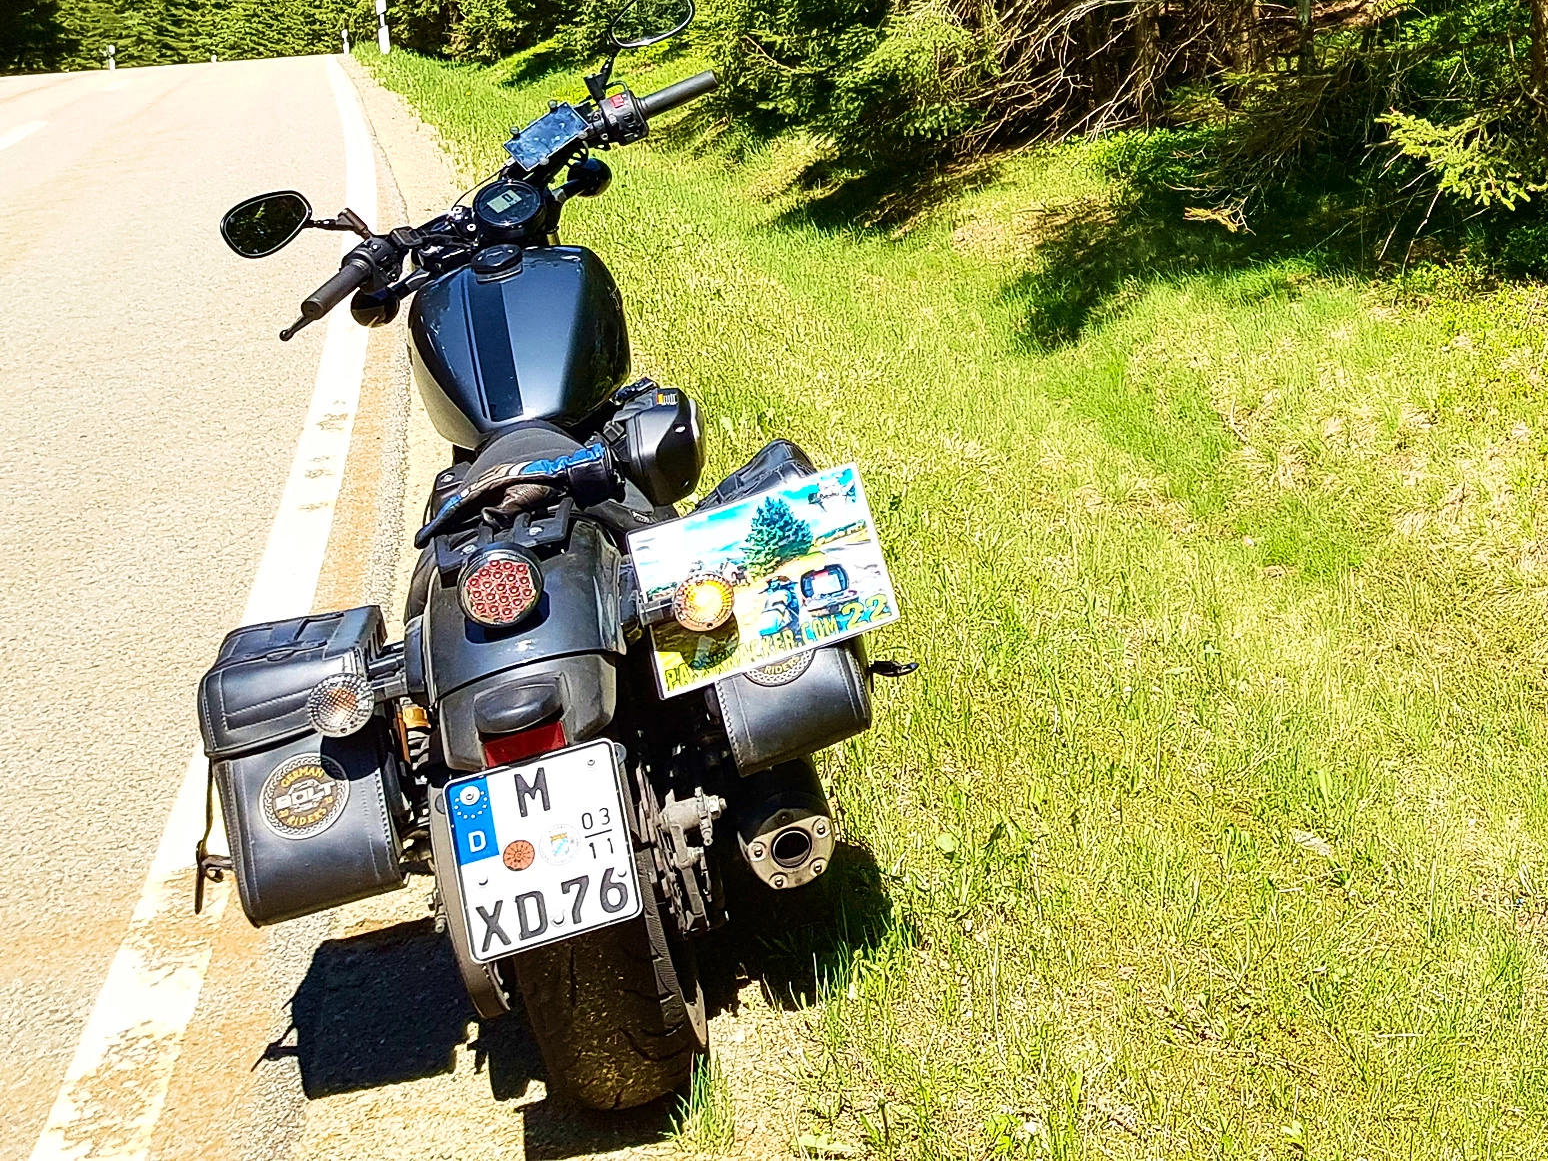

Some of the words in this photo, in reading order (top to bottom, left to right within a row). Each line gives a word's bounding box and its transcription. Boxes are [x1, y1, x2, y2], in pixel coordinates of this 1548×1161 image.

[281, 766, 325, 788] GERMAN
[275, 781, 336, 811] BOLT
[514, 767, 550, 817] M
[287, 808, 328, 827] RIDERS
[581, 807, 611, 830] 03
[468, 830, 487, 853] D
[589, 837, 613, 859] 11
